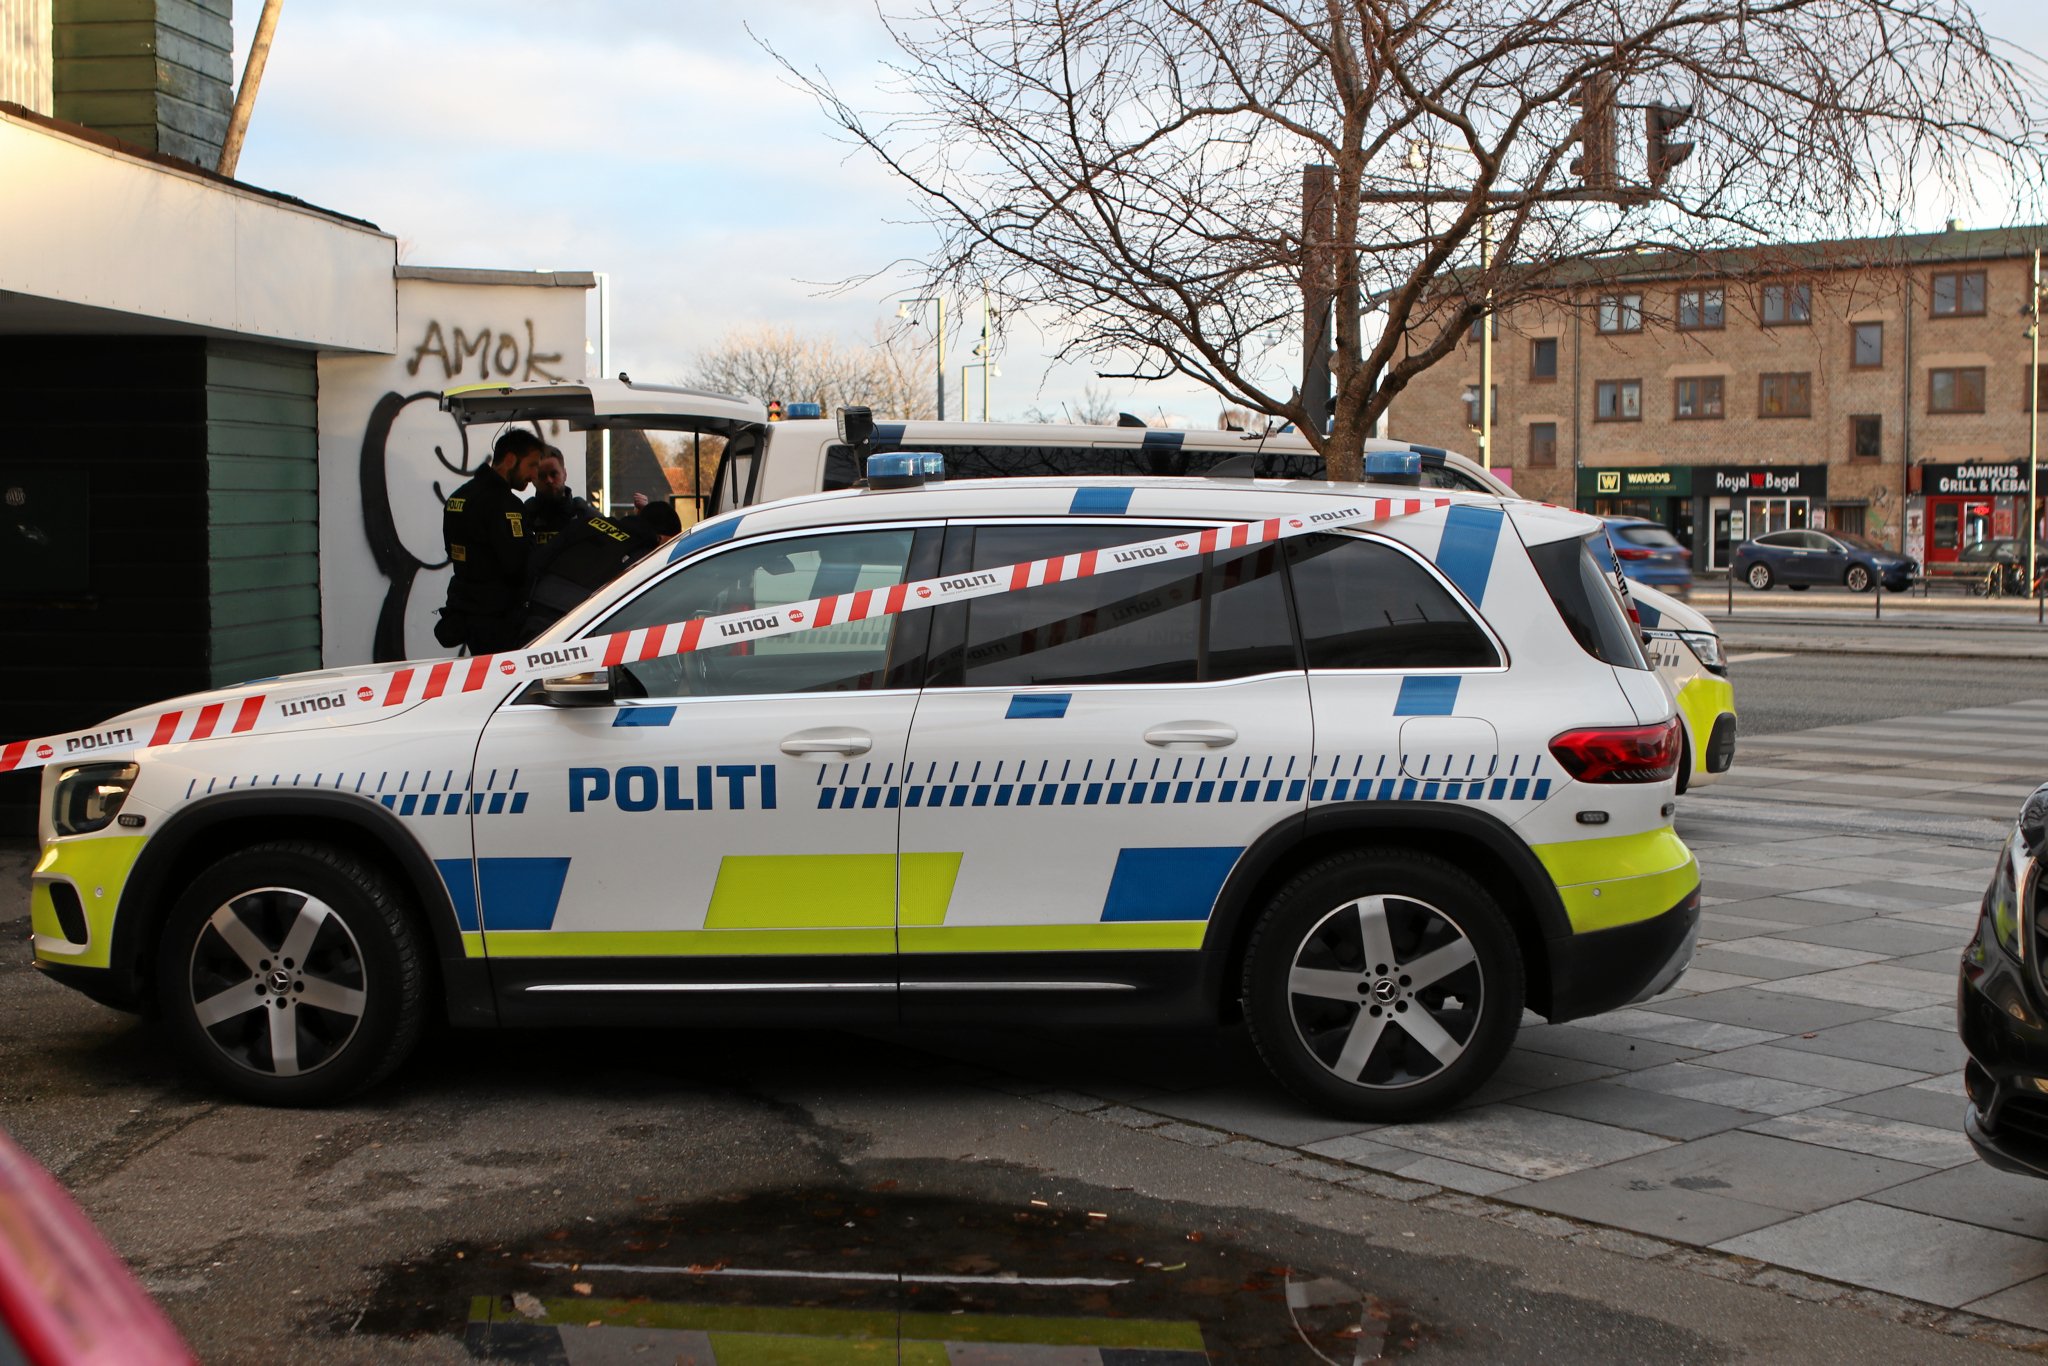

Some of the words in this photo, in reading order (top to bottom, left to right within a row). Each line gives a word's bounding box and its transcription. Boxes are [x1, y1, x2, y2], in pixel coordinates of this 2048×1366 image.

[1628, 473, 1671, 483] WAYGO'S
[1957, 466, 2018, 478] DAMHUS
[1601, 475, 1617, 489] W
[1716, 472, 1749, 492] Royal
[1765, 472, 1800, 492] Bagel
[1940, 477, 1977, 492] GRILL
[1979, 479, 1989, 491] &
[1991, 477, 2030, 492] KEBA
[1309, 507, 1361, 523] POLITI
[1114, 545, 1167, 563] POLITI
[1611, 552, 1629, 597] POLITI
[940, 574, 996, 592] POLITI
[917, 588, 931, 596] STOP
[789, 612, 804, 620] STOP
[720, 616, 779, 637] POLITI
[526, 646, 588, 667] POLITI
[500, 664, 516, 672] STOP
[358, 690, 373, 698] STOP
[281, 694, 346, 717] POLITI
[66, 728, 133, 752] POLITI
[37, 749, 53, 758] STOP
[569, 764, 777, 812] POLITI
